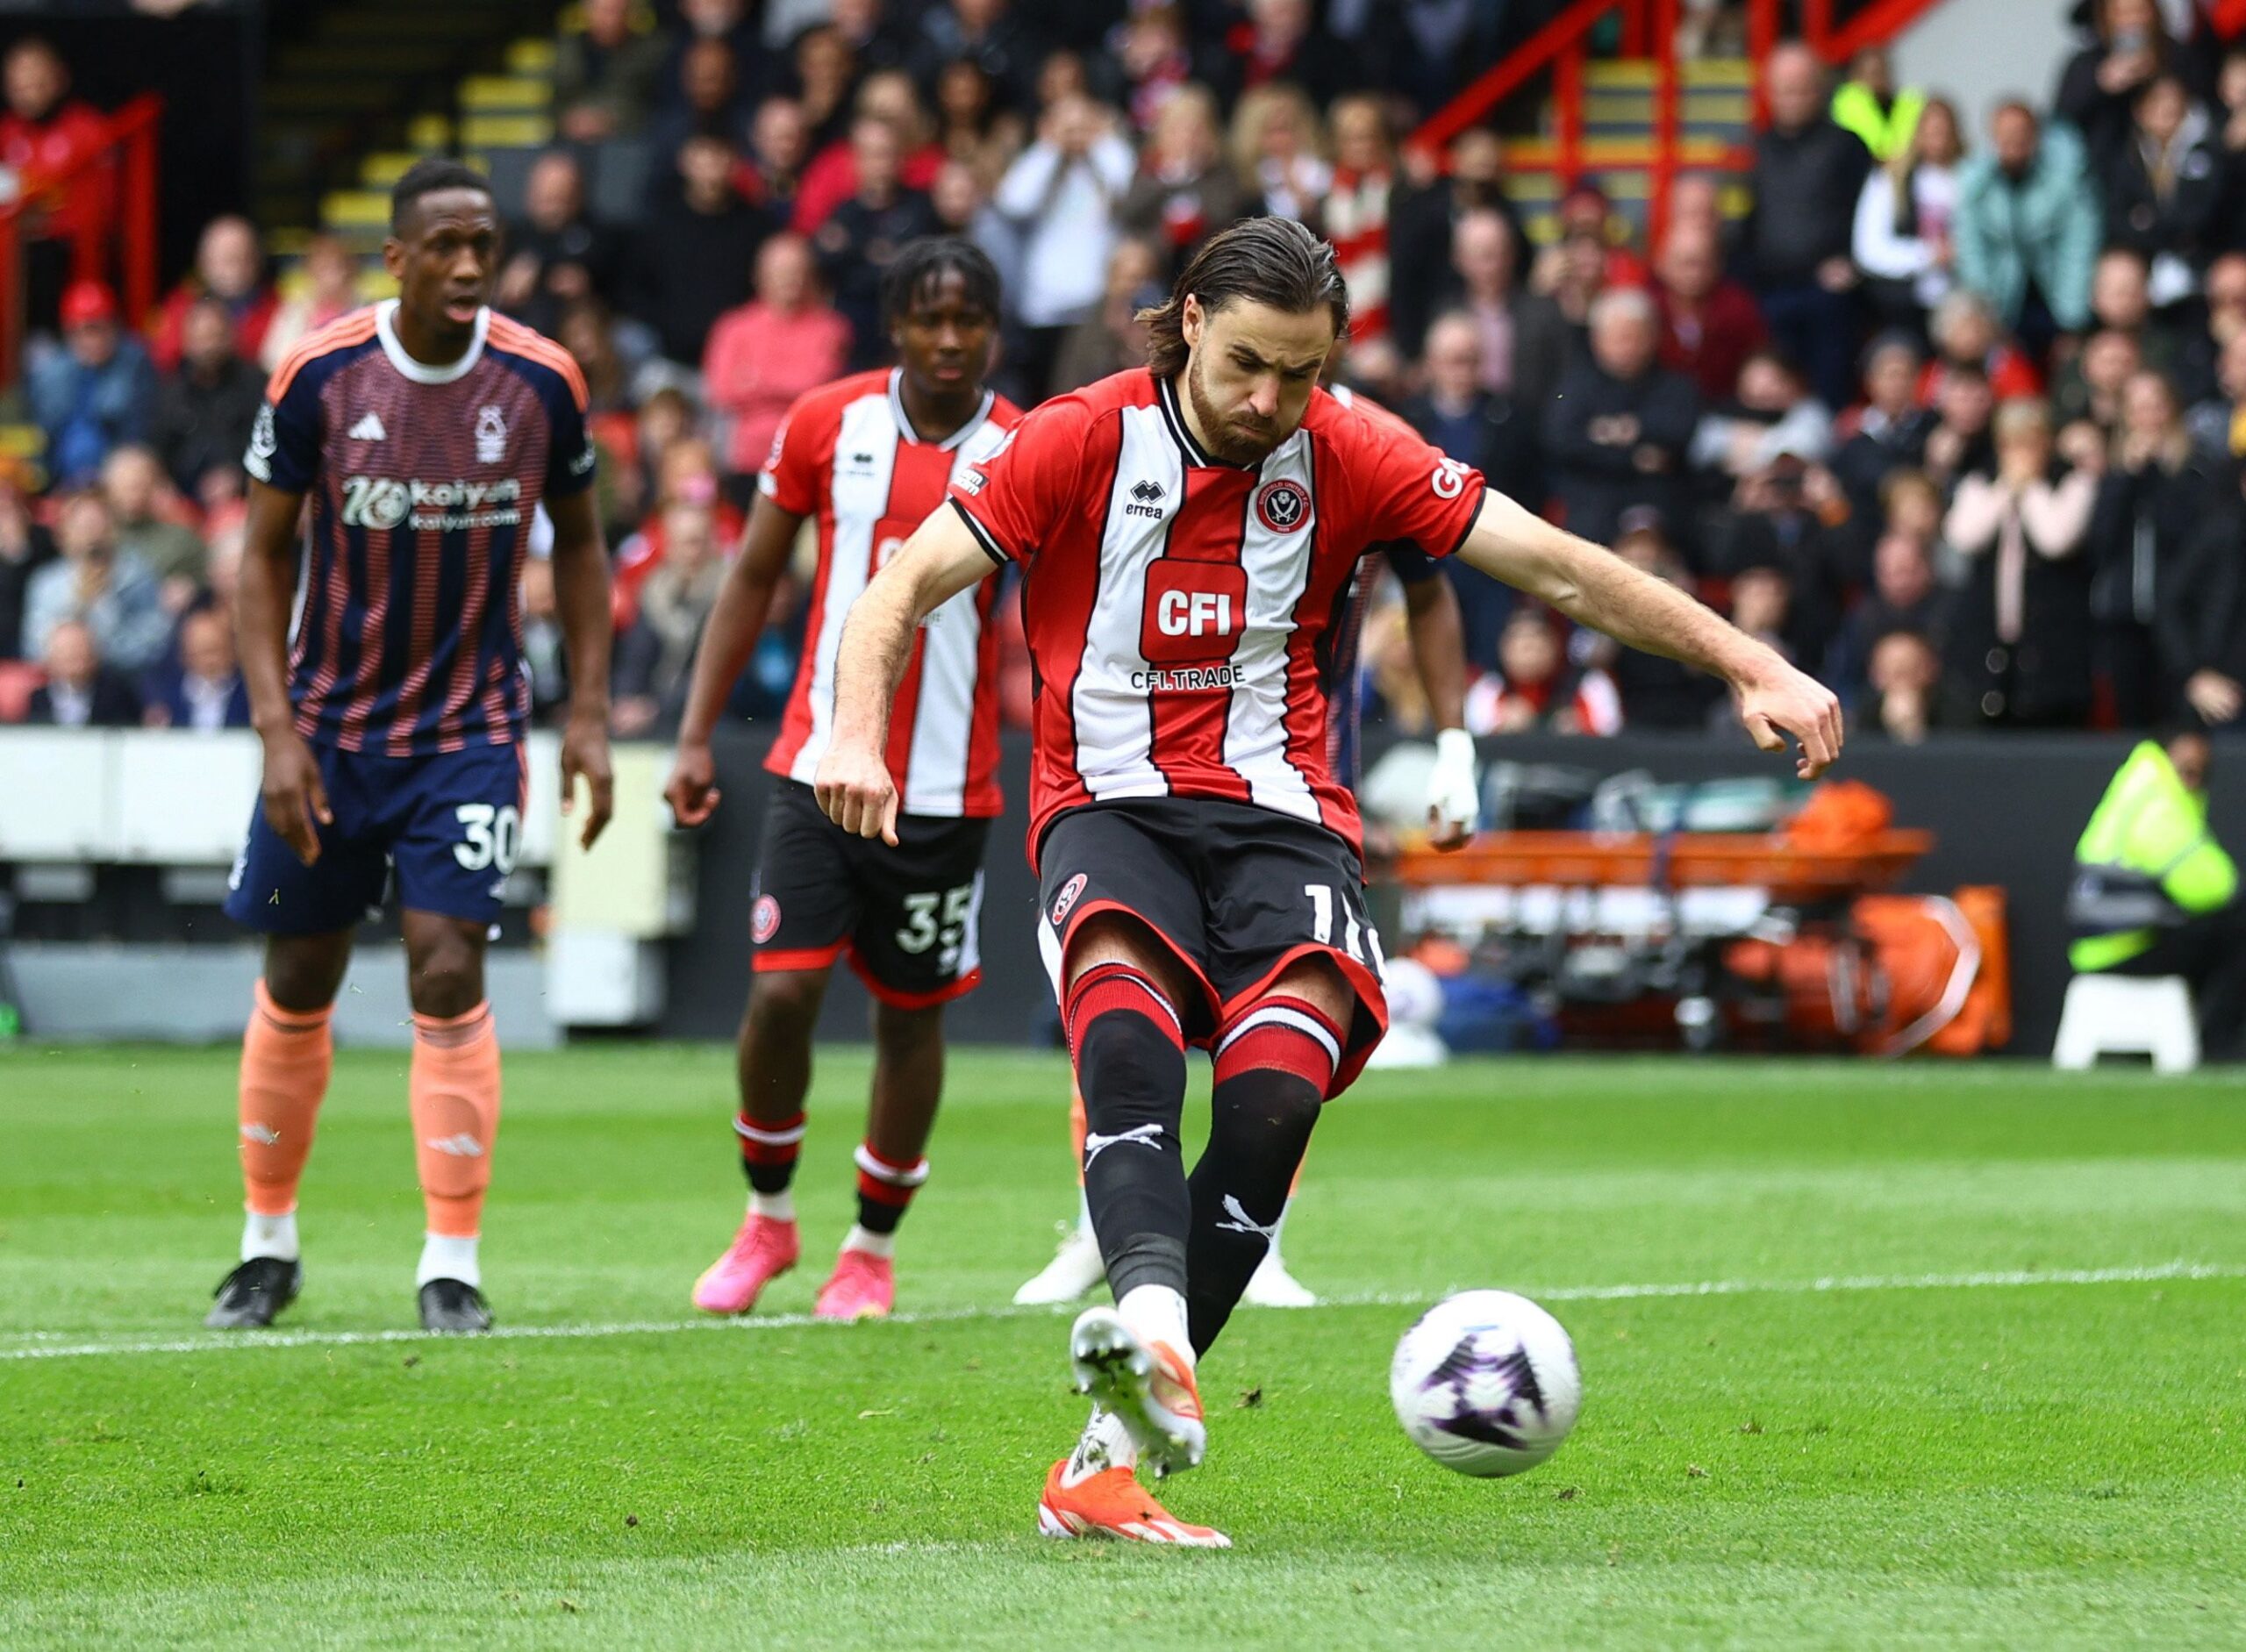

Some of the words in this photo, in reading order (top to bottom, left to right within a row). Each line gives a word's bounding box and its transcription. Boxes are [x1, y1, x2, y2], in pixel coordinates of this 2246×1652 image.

[1126, 504, 1163, 520] errea
[1157, 589, 1231, 637] CFI
[1130, 664, 1247, 690] CFI.TRADE
[452, 803, 521, 876] 30
[895, 884, 972, 955] 35
